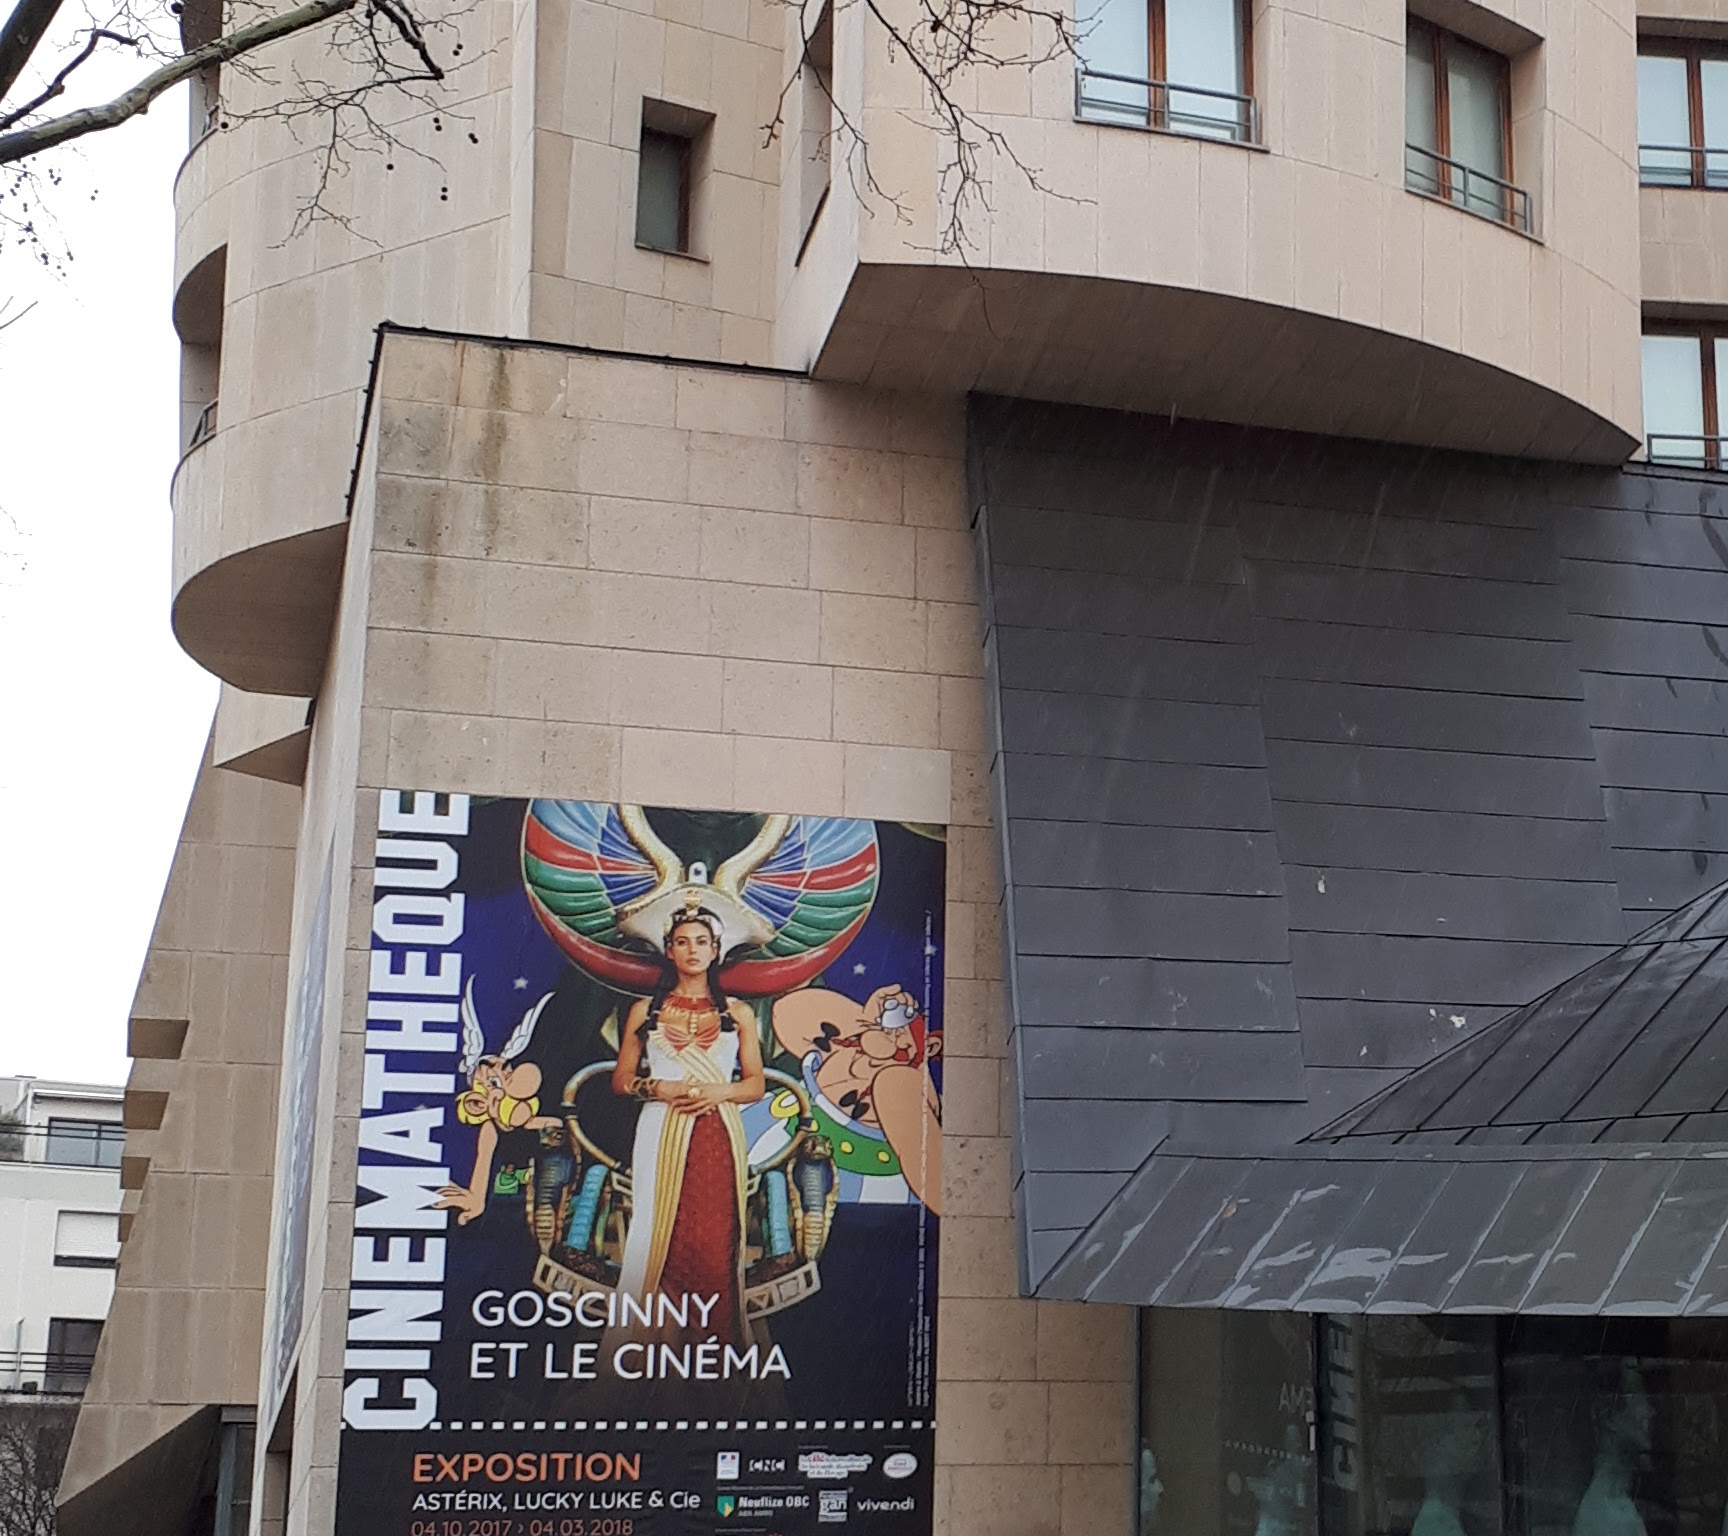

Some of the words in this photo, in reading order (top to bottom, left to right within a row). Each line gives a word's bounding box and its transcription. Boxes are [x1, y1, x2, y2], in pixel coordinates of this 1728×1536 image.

[342, 789, 471, 1431] CINEMATHEQUE
[472, 1289, 720, 1328] GOSCINNY
[470, 1341, 529, 1379] ET
[545, 1342, 599, 1379] LE
[613, 1335, 792, 1380] CINÉMA
[413, 1452, 641, 1483] EXPOSITION
[412, 1489, 507, 1513] ASTÉRIX,
[514, 1492, 584, 1510] LUCKY
[589, 1491, 643, 1509] LUKE
[648, 1490, 665, 1509] &
[669, 1489, 701, 1509] Cie
[785, 1495, 810, 1508] OBC
[856, 1496, 915, 1512] vivendi
